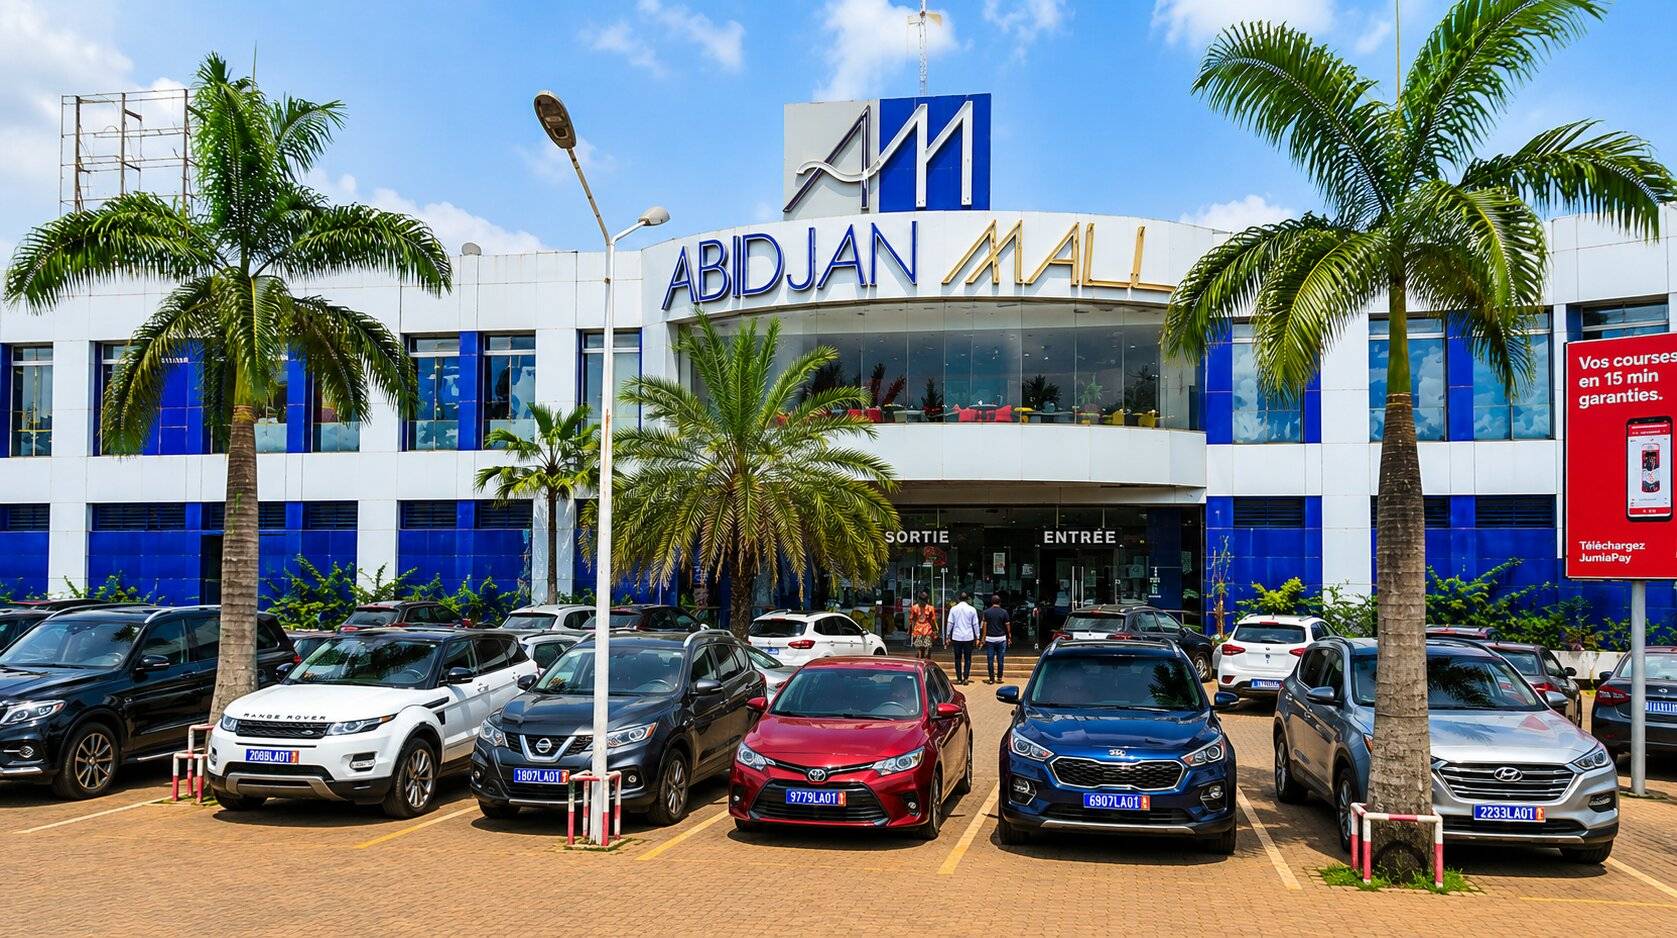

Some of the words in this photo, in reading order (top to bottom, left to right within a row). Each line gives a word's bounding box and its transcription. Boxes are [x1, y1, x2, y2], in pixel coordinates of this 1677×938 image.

[784, 103, 973, 213] AM
[661, 221, 918, 311] ABIDJAN
[941, 219, 1177, 292] MALL
[1579, 355, 1609, 370] Vos
[1613, 352, 1677, 367] courses
[1579, 376, 1599, 388] en
[1604, 371, 1623, 386] 15
[1627, 368, 1659, 384] min
[1579, 388, 1663, 409] garanties.
[885, 530, 949, 543] SORTIE
[1044, 528, 1117, 543] ENTRÉE
[1579, 541, 1645, 552] Téléchargez
[1579, 553, 1631, 564] JumiaPay
[517, 770, 560, 783] 1807LA01
[790, 791, 836, 805] 9779LA01
[1089, 795, 1139, 808] 6907LA01
[1480, 806, 1534, 819] 2233LA01
